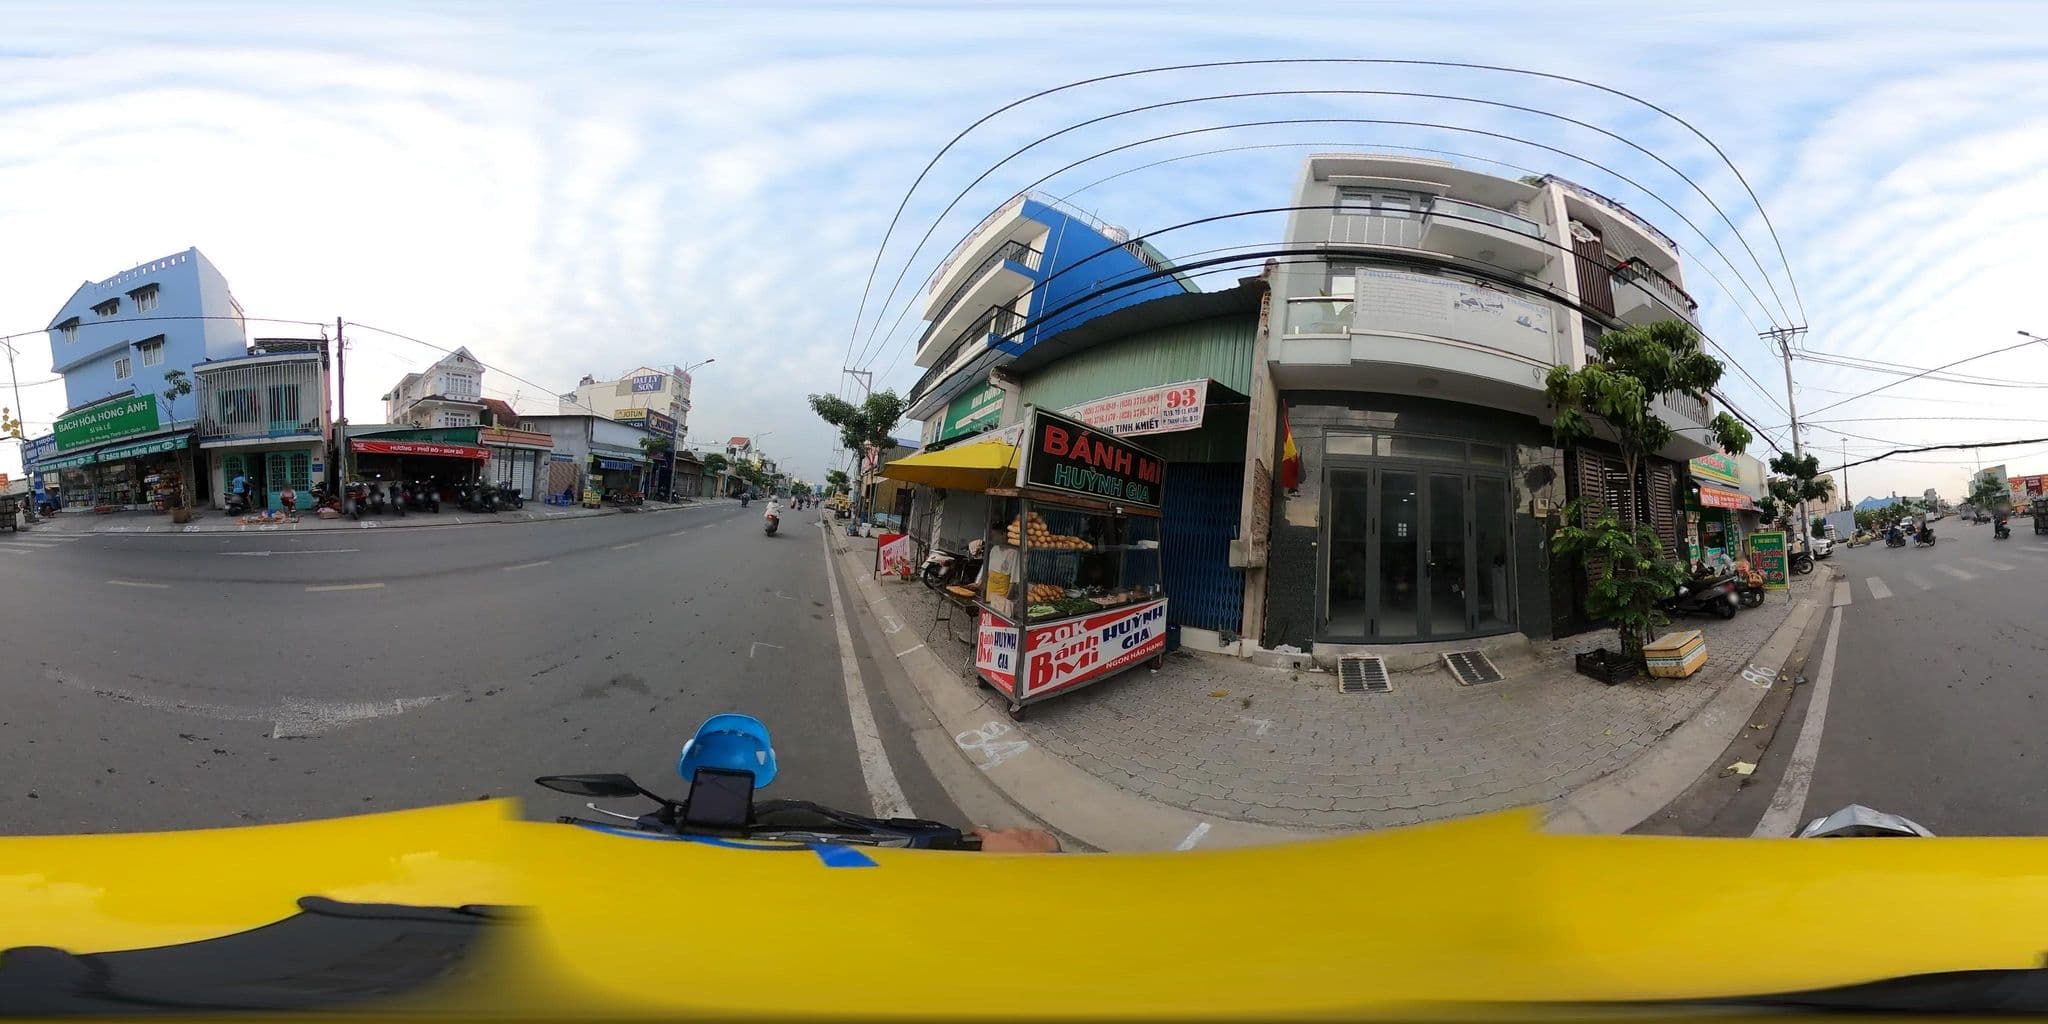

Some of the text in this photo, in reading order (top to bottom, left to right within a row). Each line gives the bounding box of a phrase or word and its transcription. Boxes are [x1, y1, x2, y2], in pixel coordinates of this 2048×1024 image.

[1167, 388, 1196, 408] 93
[1044, 424, 1132, 475] BÁNH
[1054, 463, 1150, 502] HUỲNH GIA
[1036, 620, 1088, 648] 20K
[1122, 628, 1150, 650] GIA
[1029, 635, 1098, 690] Bánh
[1102, 604, 1164, 642] HUỲNH
[998, 653, 1008, 670] GIA
[1105, 655, 1128, 670] NGON
